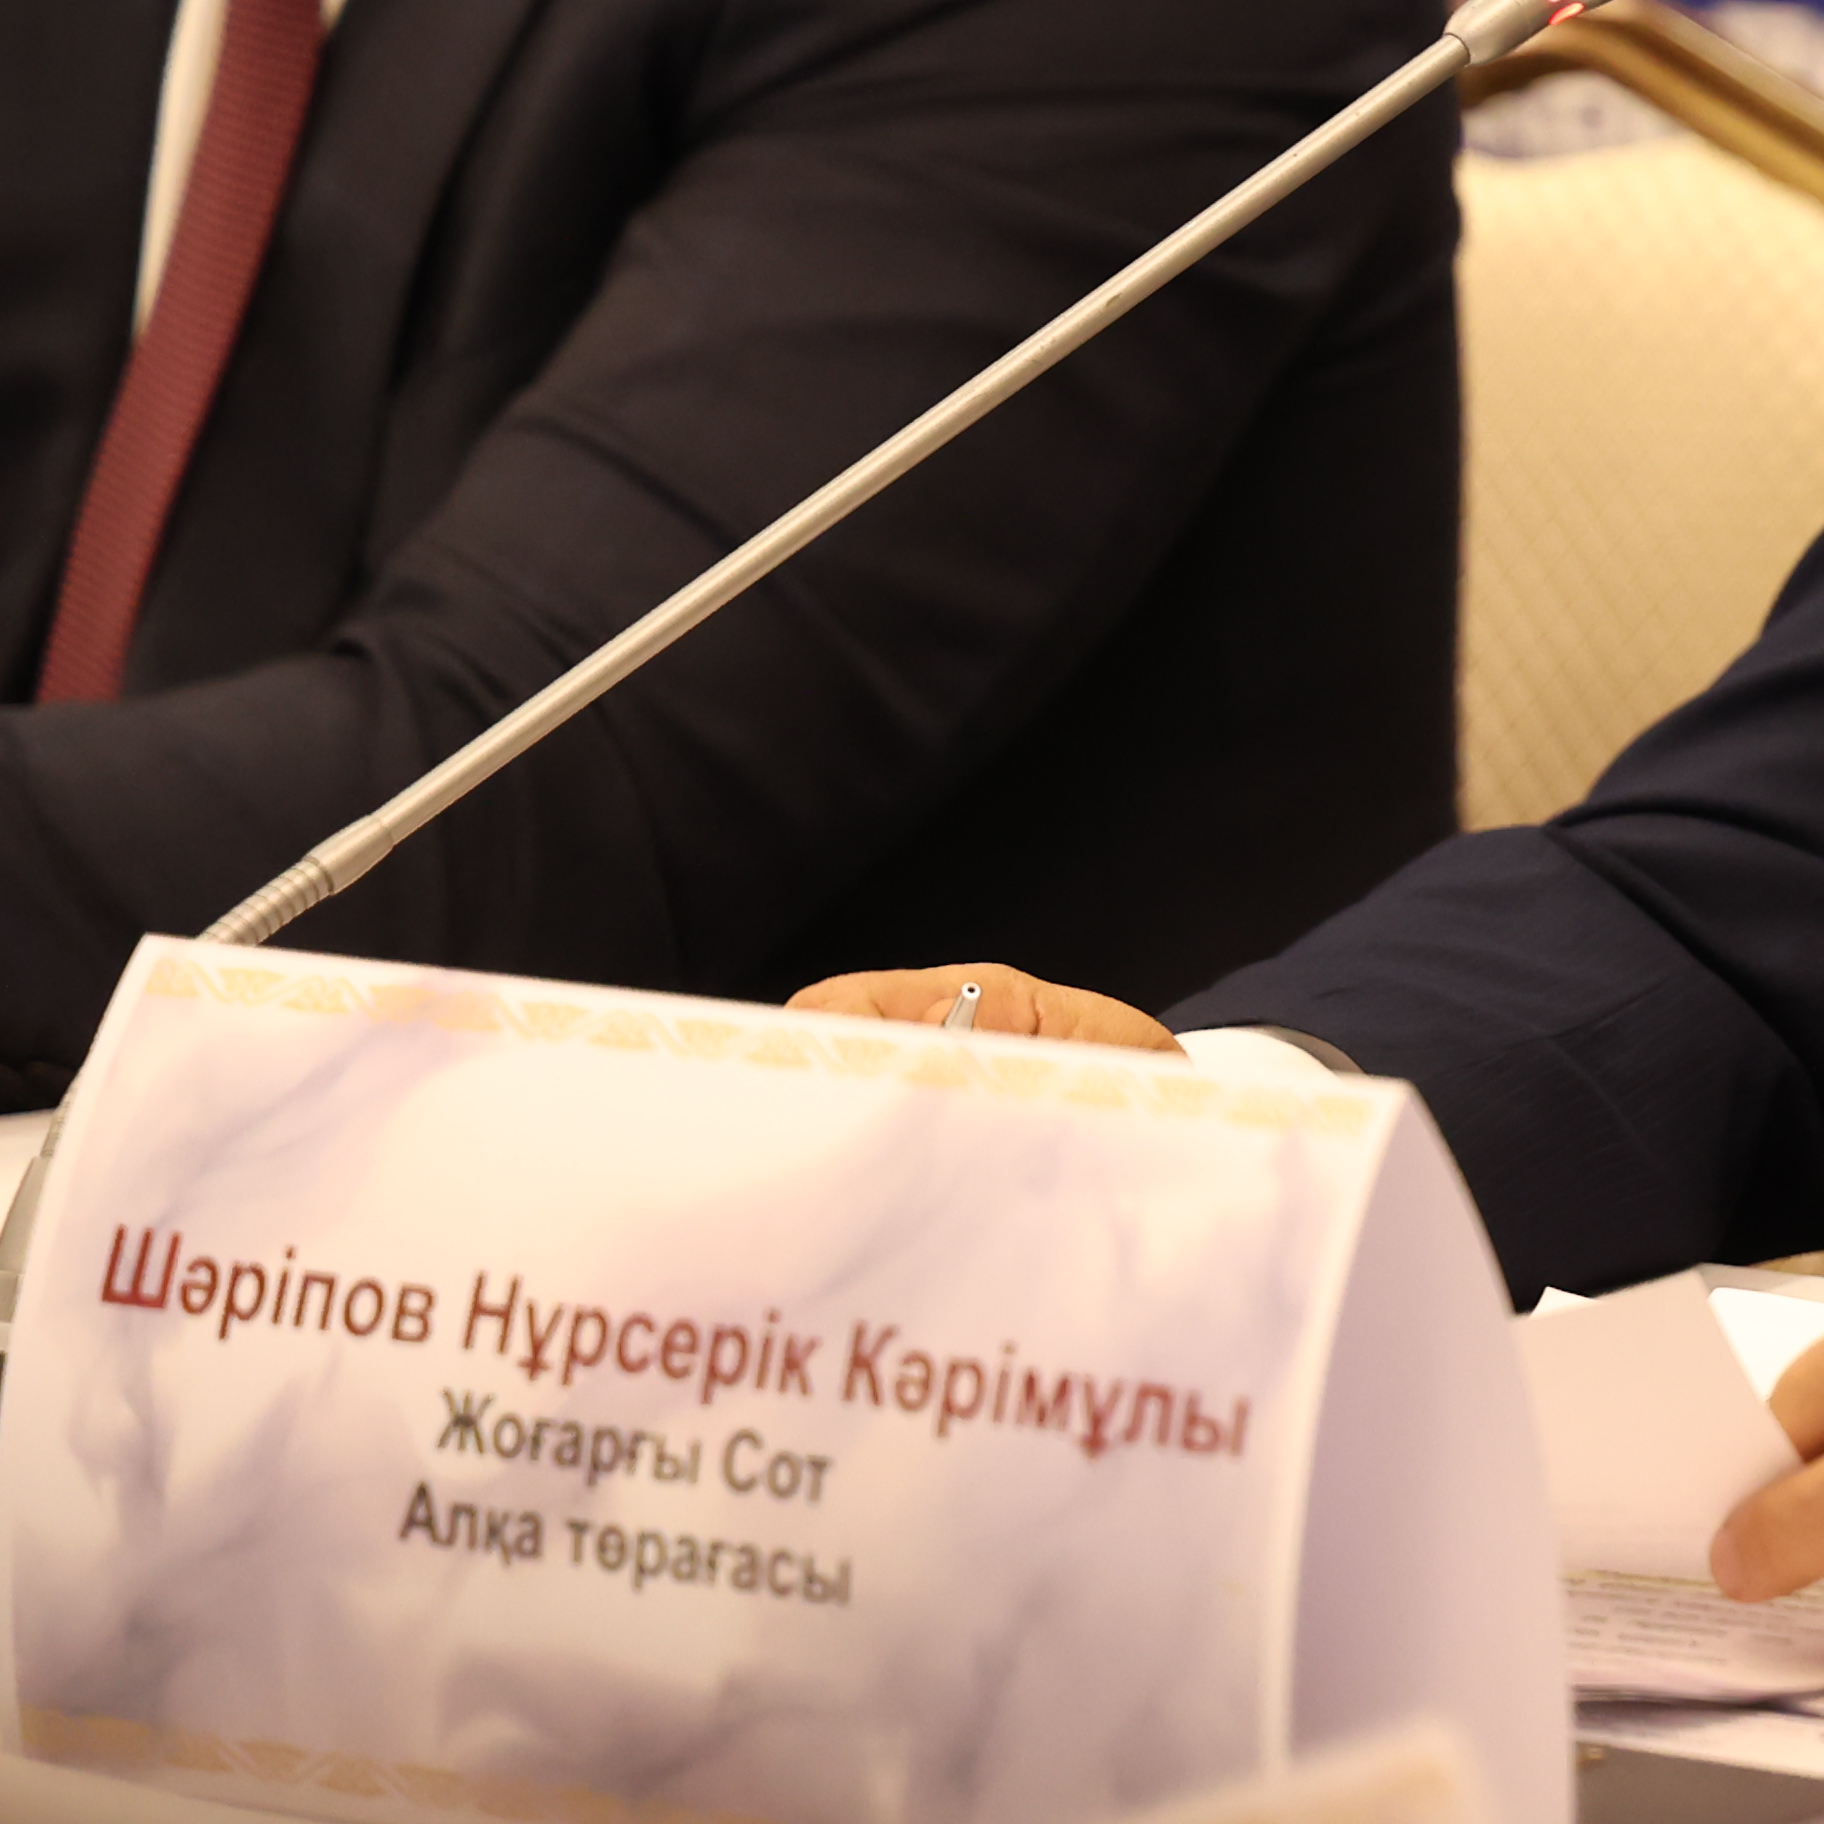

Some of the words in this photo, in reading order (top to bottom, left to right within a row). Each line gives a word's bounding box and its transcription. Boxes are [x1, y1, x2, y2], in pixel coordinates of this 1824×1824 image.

[101, 1223, 436, 1341] Шәріпов
[462, 1271, 821, 1404] Нұрсерік
[840, 1320, 1252, 1460] Кәрімұлы
[436, 1388, 700, 1487] Жоғарғы
[720, 1428, 834, 1503] Сот
[399, 1481, 544, 1567] Алқа
[567, 1518, 852, 1607] төрағасы
